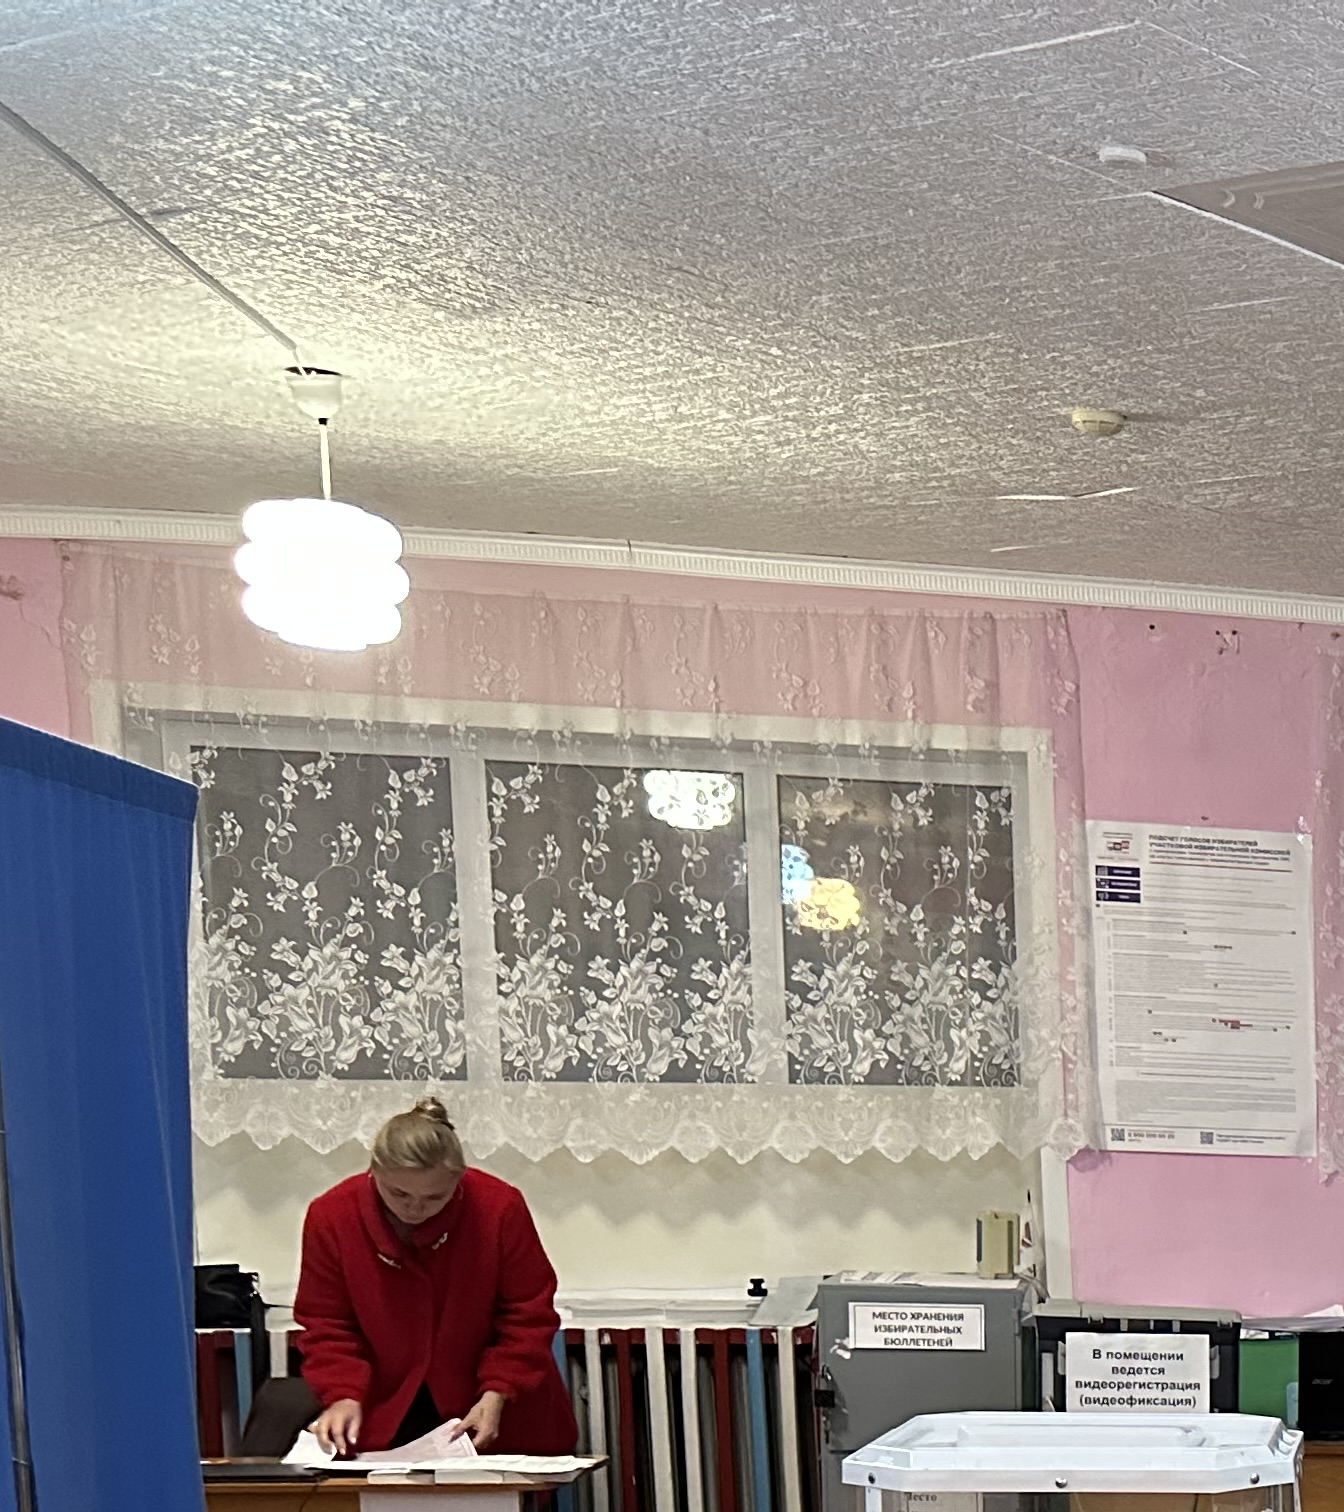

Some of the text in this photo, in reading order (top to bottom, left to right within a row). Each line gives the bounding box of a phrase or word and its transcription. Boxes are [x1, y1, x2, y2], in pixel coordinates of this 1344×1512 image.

[872, 1311, 964, 1322] МЕСТО ХРАНЕНИЯ
[874, 1325, 963, 1335] ИЗБИРАТЕЛЬНЫХ
[884, 1337, 953, 1347] БЮЛЛЕТЕНЕЙ
[1092, 1349, 1184, 1362] В помещении
[1111, 1366, 1165, 1376] ведется
[1075, 1380, 1201, 1391] видеорегистрация
[1079, 1394, 1197, 1408] (видеофиксация)
